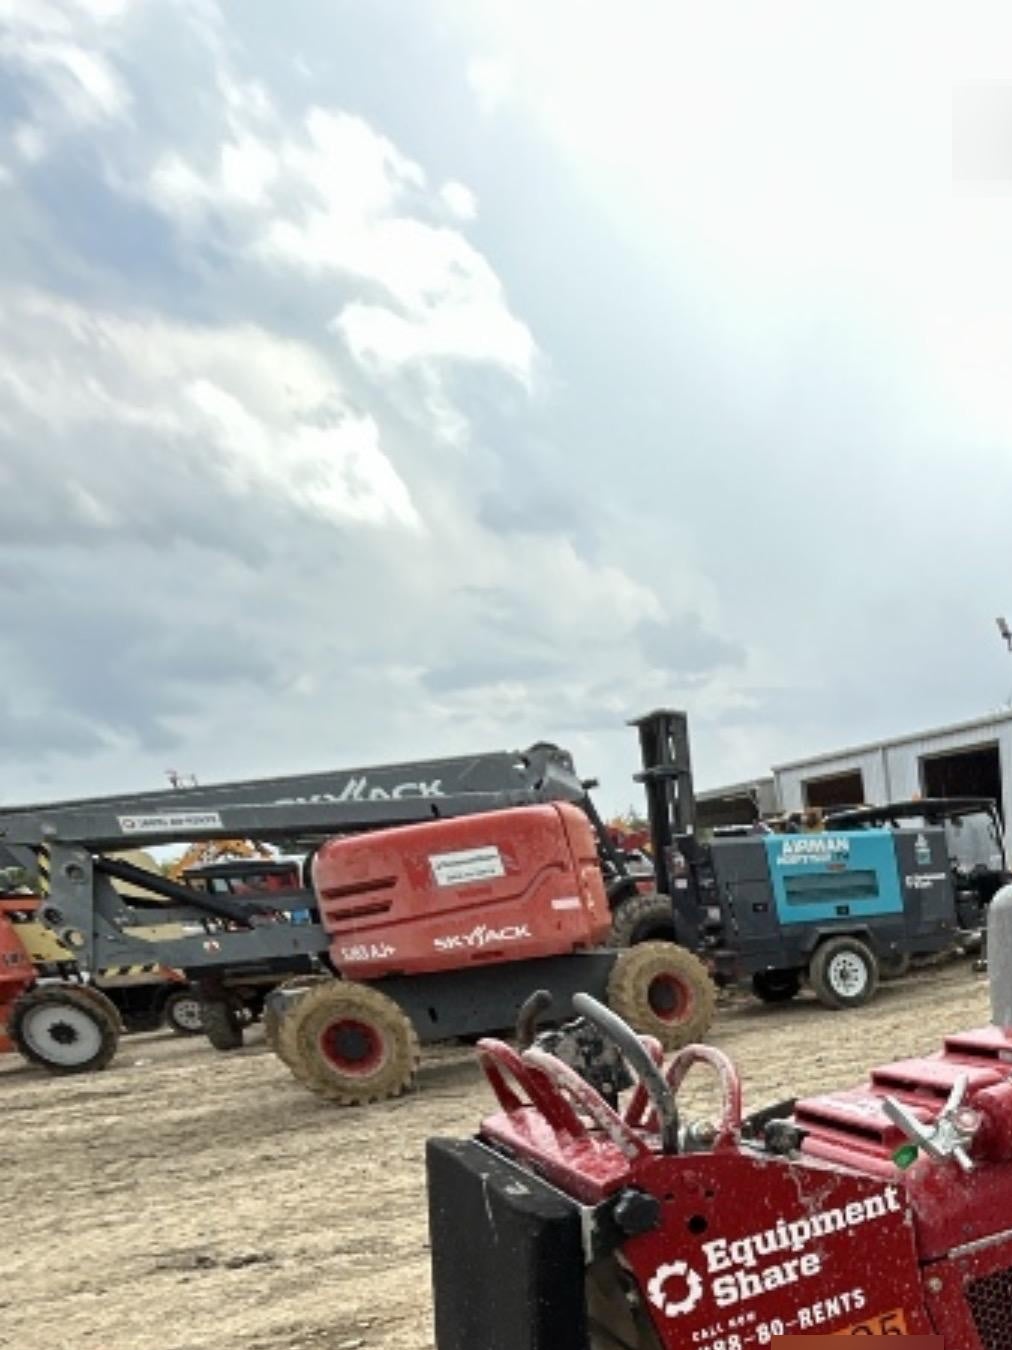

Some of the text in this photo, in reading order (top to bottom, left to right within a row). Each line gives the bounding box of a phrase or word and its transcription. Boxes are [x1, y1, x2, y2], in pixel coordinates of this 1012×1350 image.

[781, 837, 850, 854] AIRMAN
[433, 923, 532, 951] SKYJACK
[702, 1185, 902, 1274] Equipment
[711, 1252, 823, 1307] Share
[691, 1322, 725, 1343] CALL
